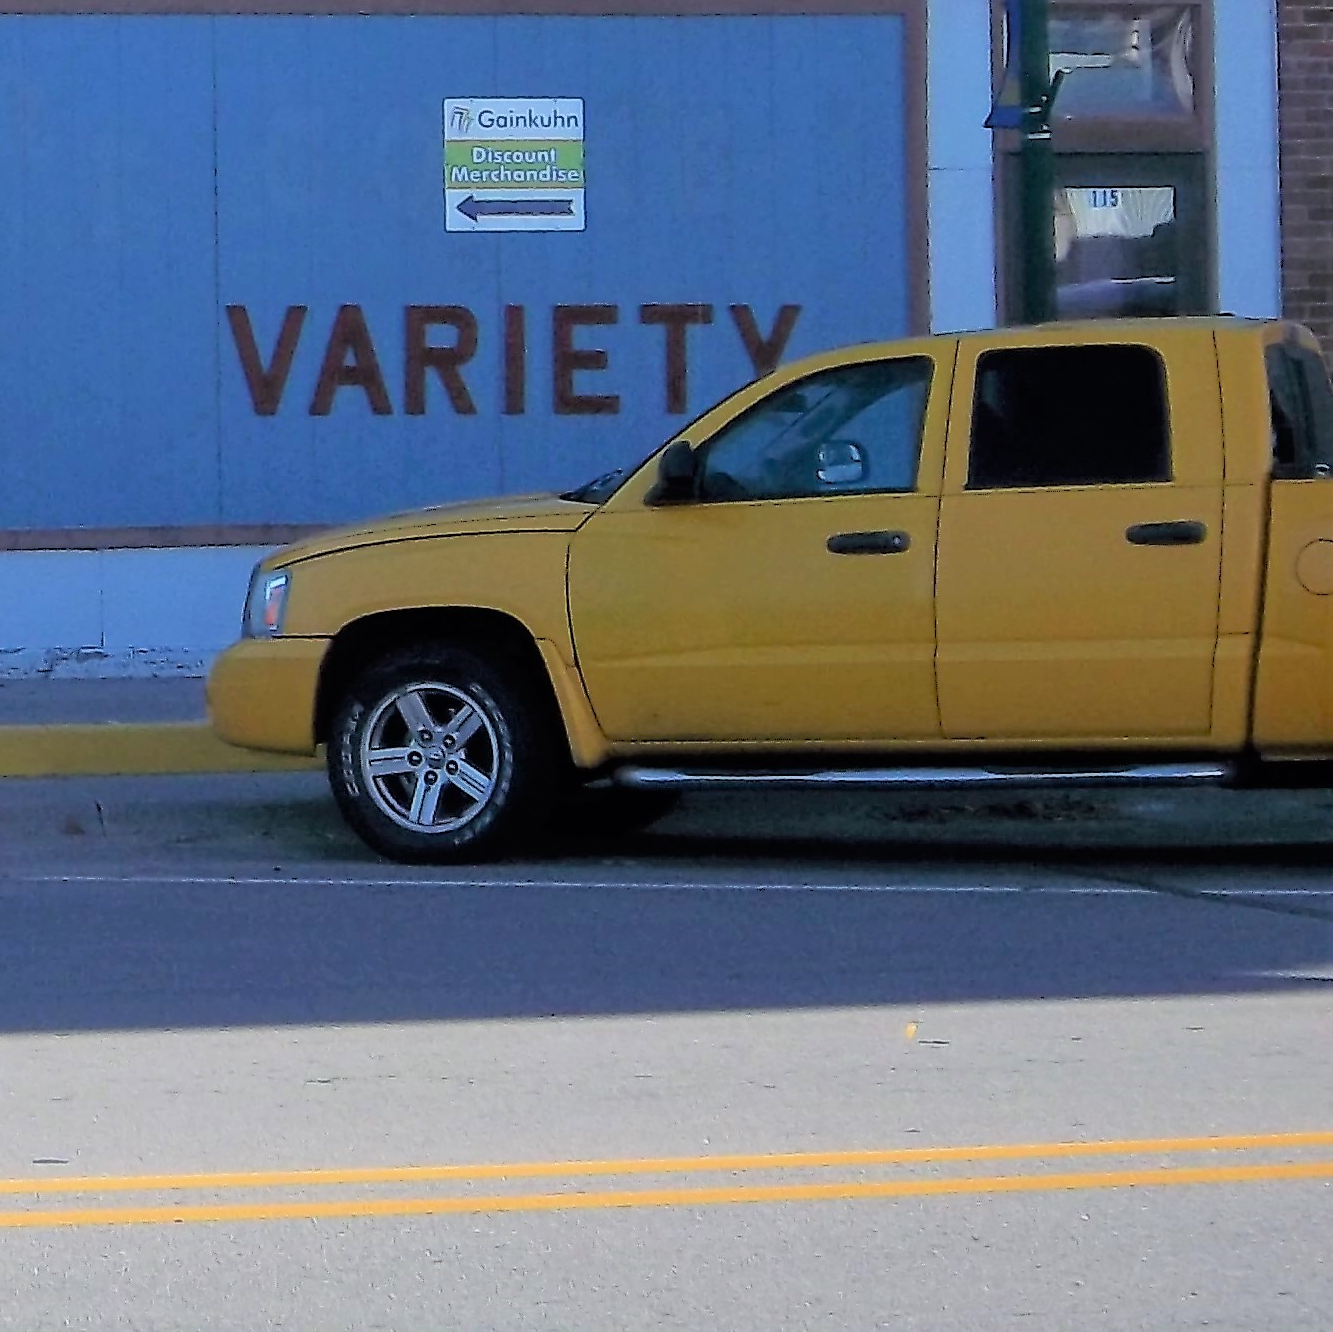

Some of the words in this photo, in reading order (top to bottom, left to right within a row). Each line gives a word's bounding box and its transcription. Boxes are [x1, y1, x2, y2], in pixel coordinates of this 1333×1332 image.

[478, 108, 579, 129] Gainkuhn
[471, 146, 557, 164] Discount
[450, 165, 581, 183] Merchandise
[1092, 190, 1119, 208] 115
[225, 304, 803, 415] VARIETY
